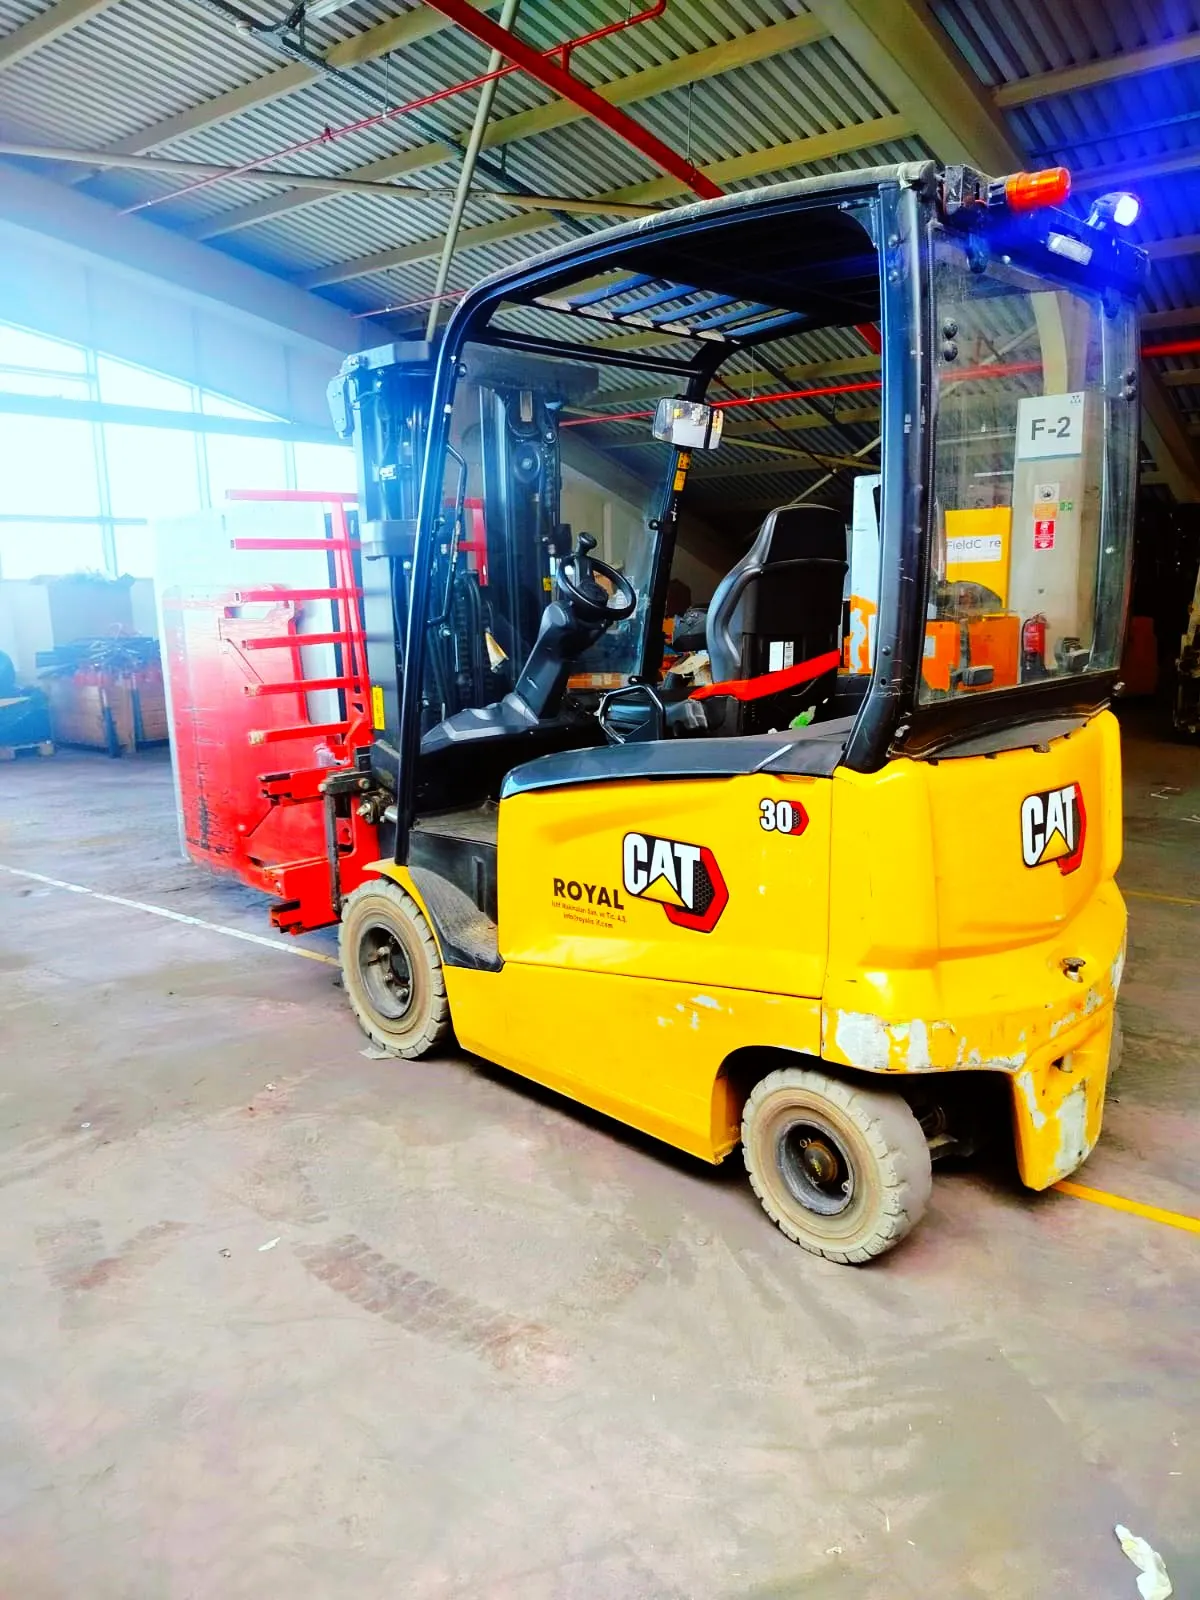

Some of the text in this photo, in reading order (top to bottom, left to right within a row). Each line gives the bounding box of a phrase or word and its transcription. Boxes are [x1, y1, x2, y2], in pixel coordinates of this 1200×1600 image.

[1031, 416, 1071, 440] F-2
[947, 538, 1001, 550] FieldCre
[759, 798, 793, 833] 30
[1021, 784, 1076, 867] CAT
[623, 832, 701, 910] CAT
[553, 877, 625, 910] ROYAL
